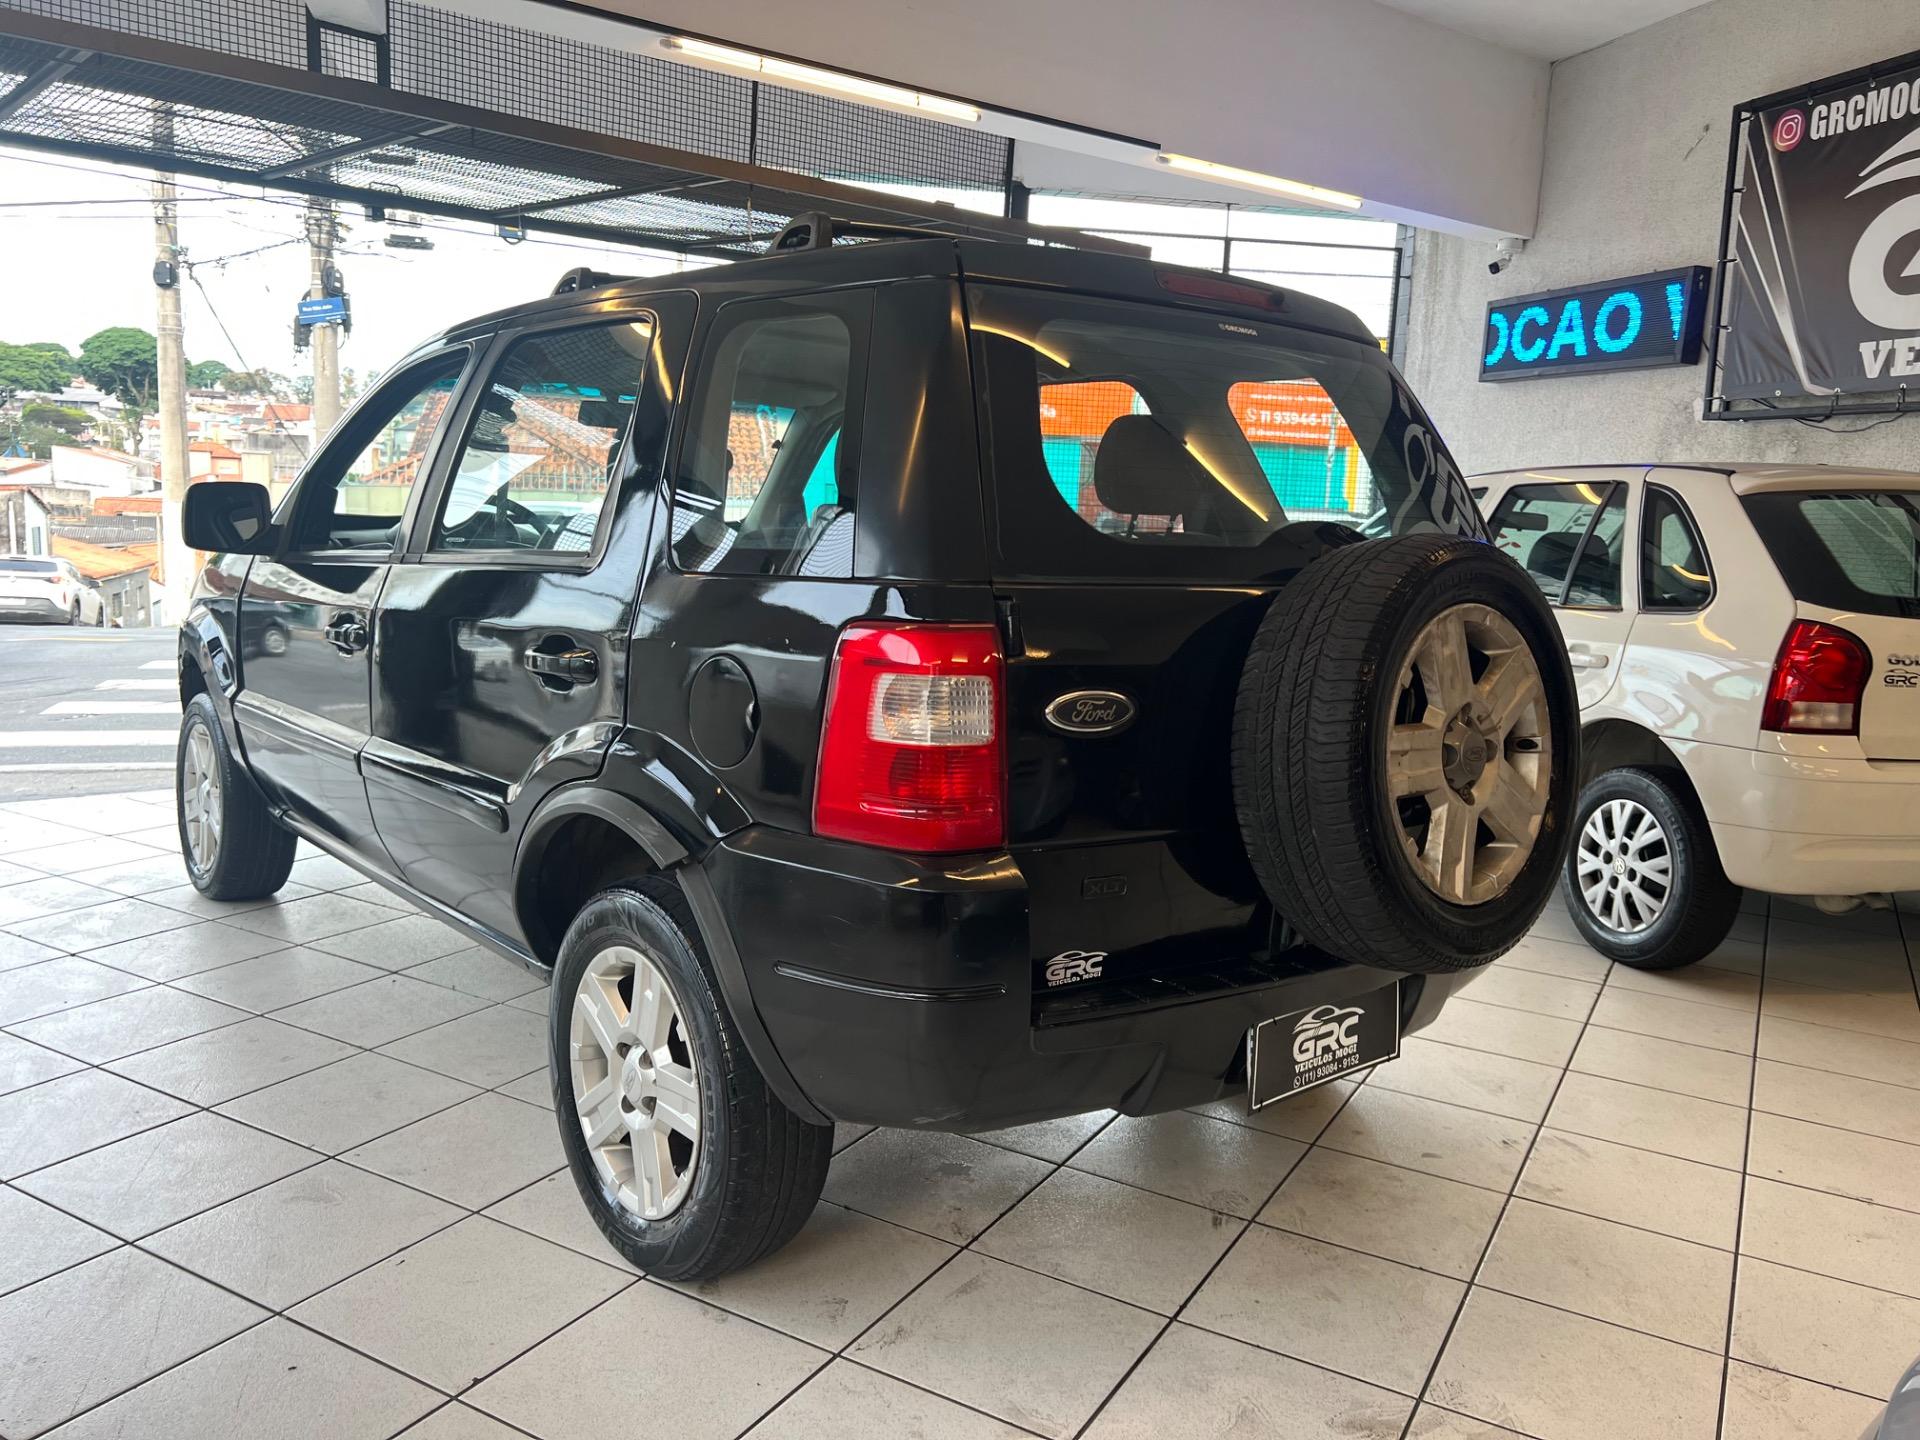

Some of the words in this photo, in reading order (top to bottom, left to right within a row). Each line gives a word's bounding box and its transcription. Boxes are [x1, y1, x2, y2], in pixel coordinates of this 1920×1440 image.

[1884, 674, 1918, 685] GRC
[1072, 700, 1117, 722] Ford
[1046, 955, 1104, 981] GRC
[1082, 971, 1102, 981] MOGI
[1292, 1014, 1359, 1063] GRC
[1294, 1052, 1333, 1074] VEICULOS
[1335, 1043, 1357, 1059] MOGI
[1301, 1072, 1316, 1086] (11)
[1316, 1065, 1338, 1079] 93084
[1342, 1053, 1360, 1069] 9152
